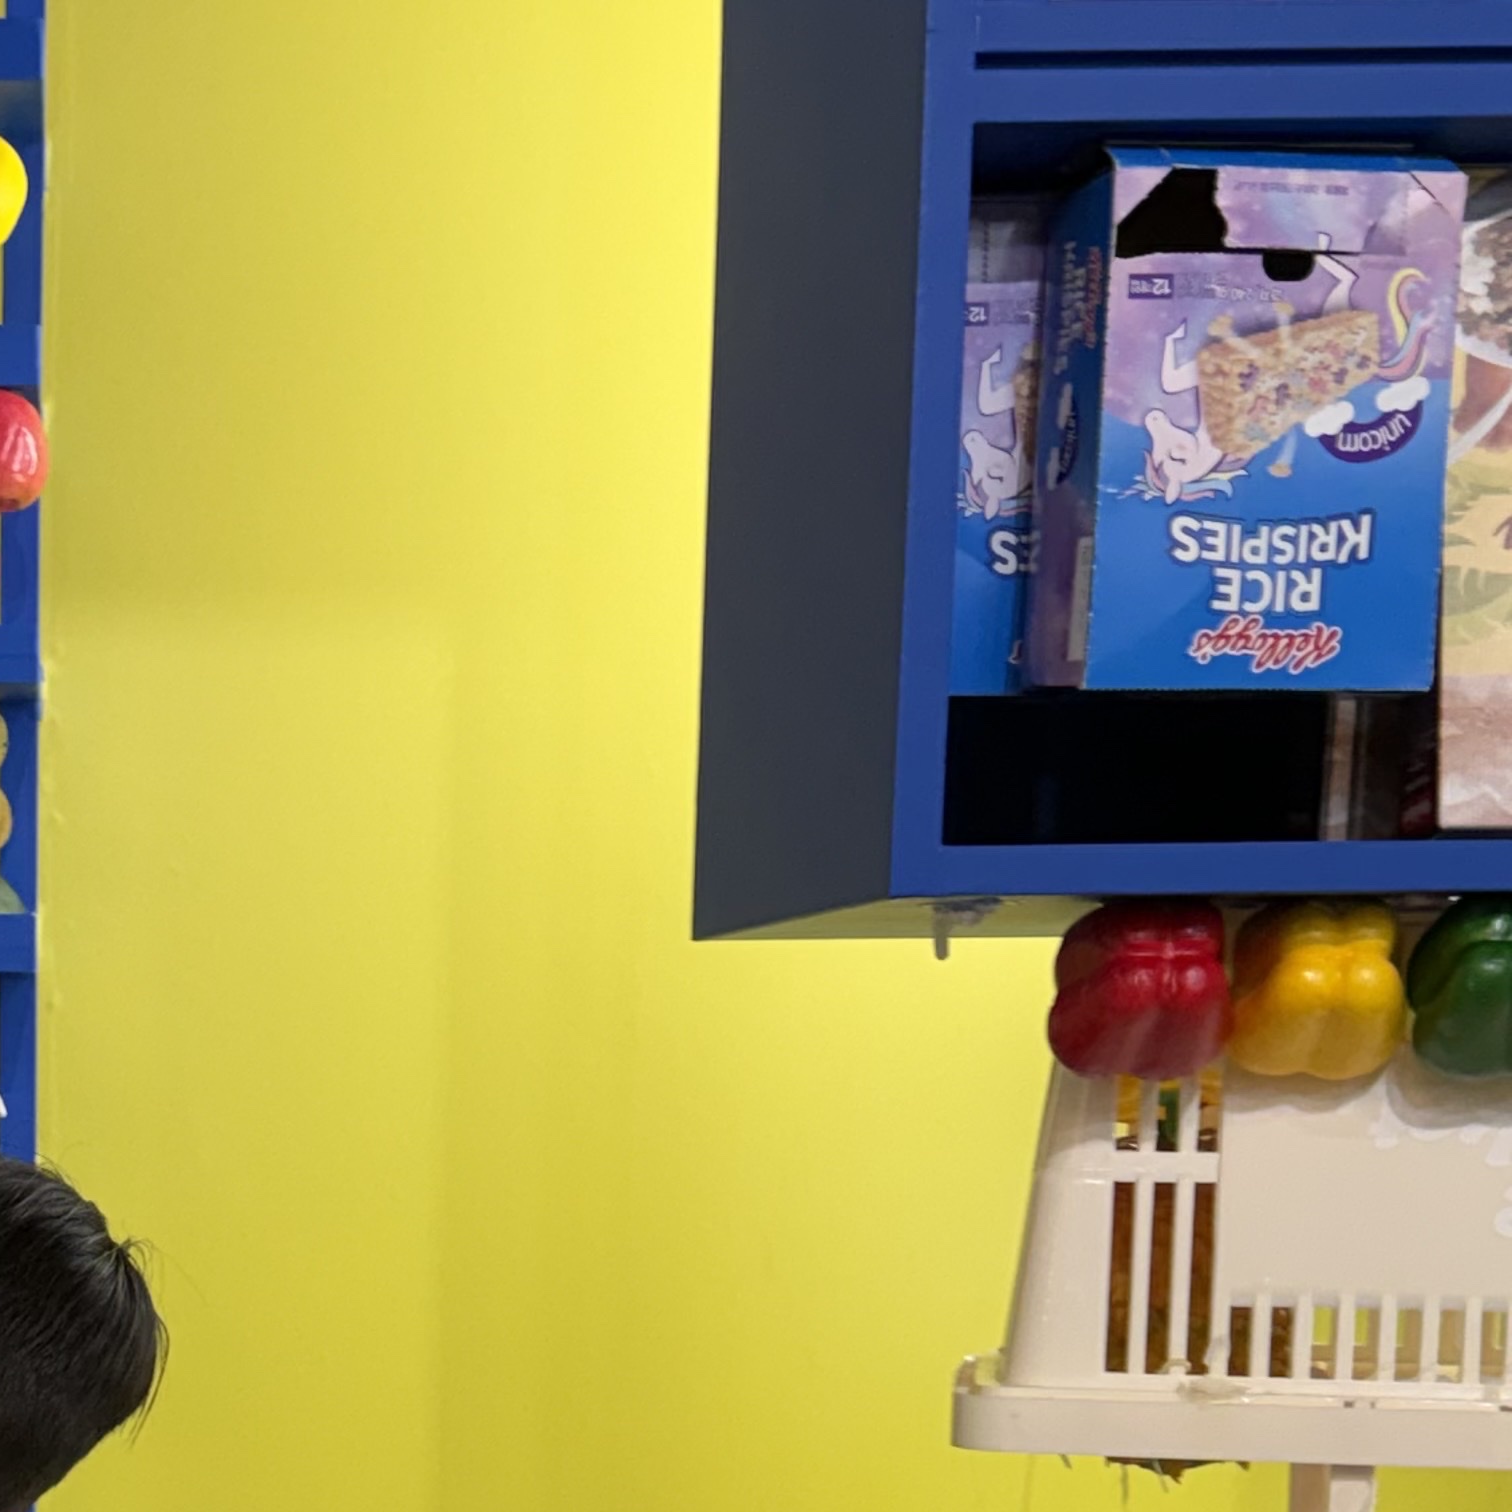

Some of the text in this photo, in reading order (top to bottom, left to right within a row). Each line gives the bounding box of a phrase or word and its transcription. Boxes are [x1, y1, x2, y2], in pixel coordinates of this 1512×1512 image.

[1170, 514, 1370, 566] KRISPIES
[1214, 567, 1322, 613] RICE
[1189, 615, 1341, 674] Kellogg's
